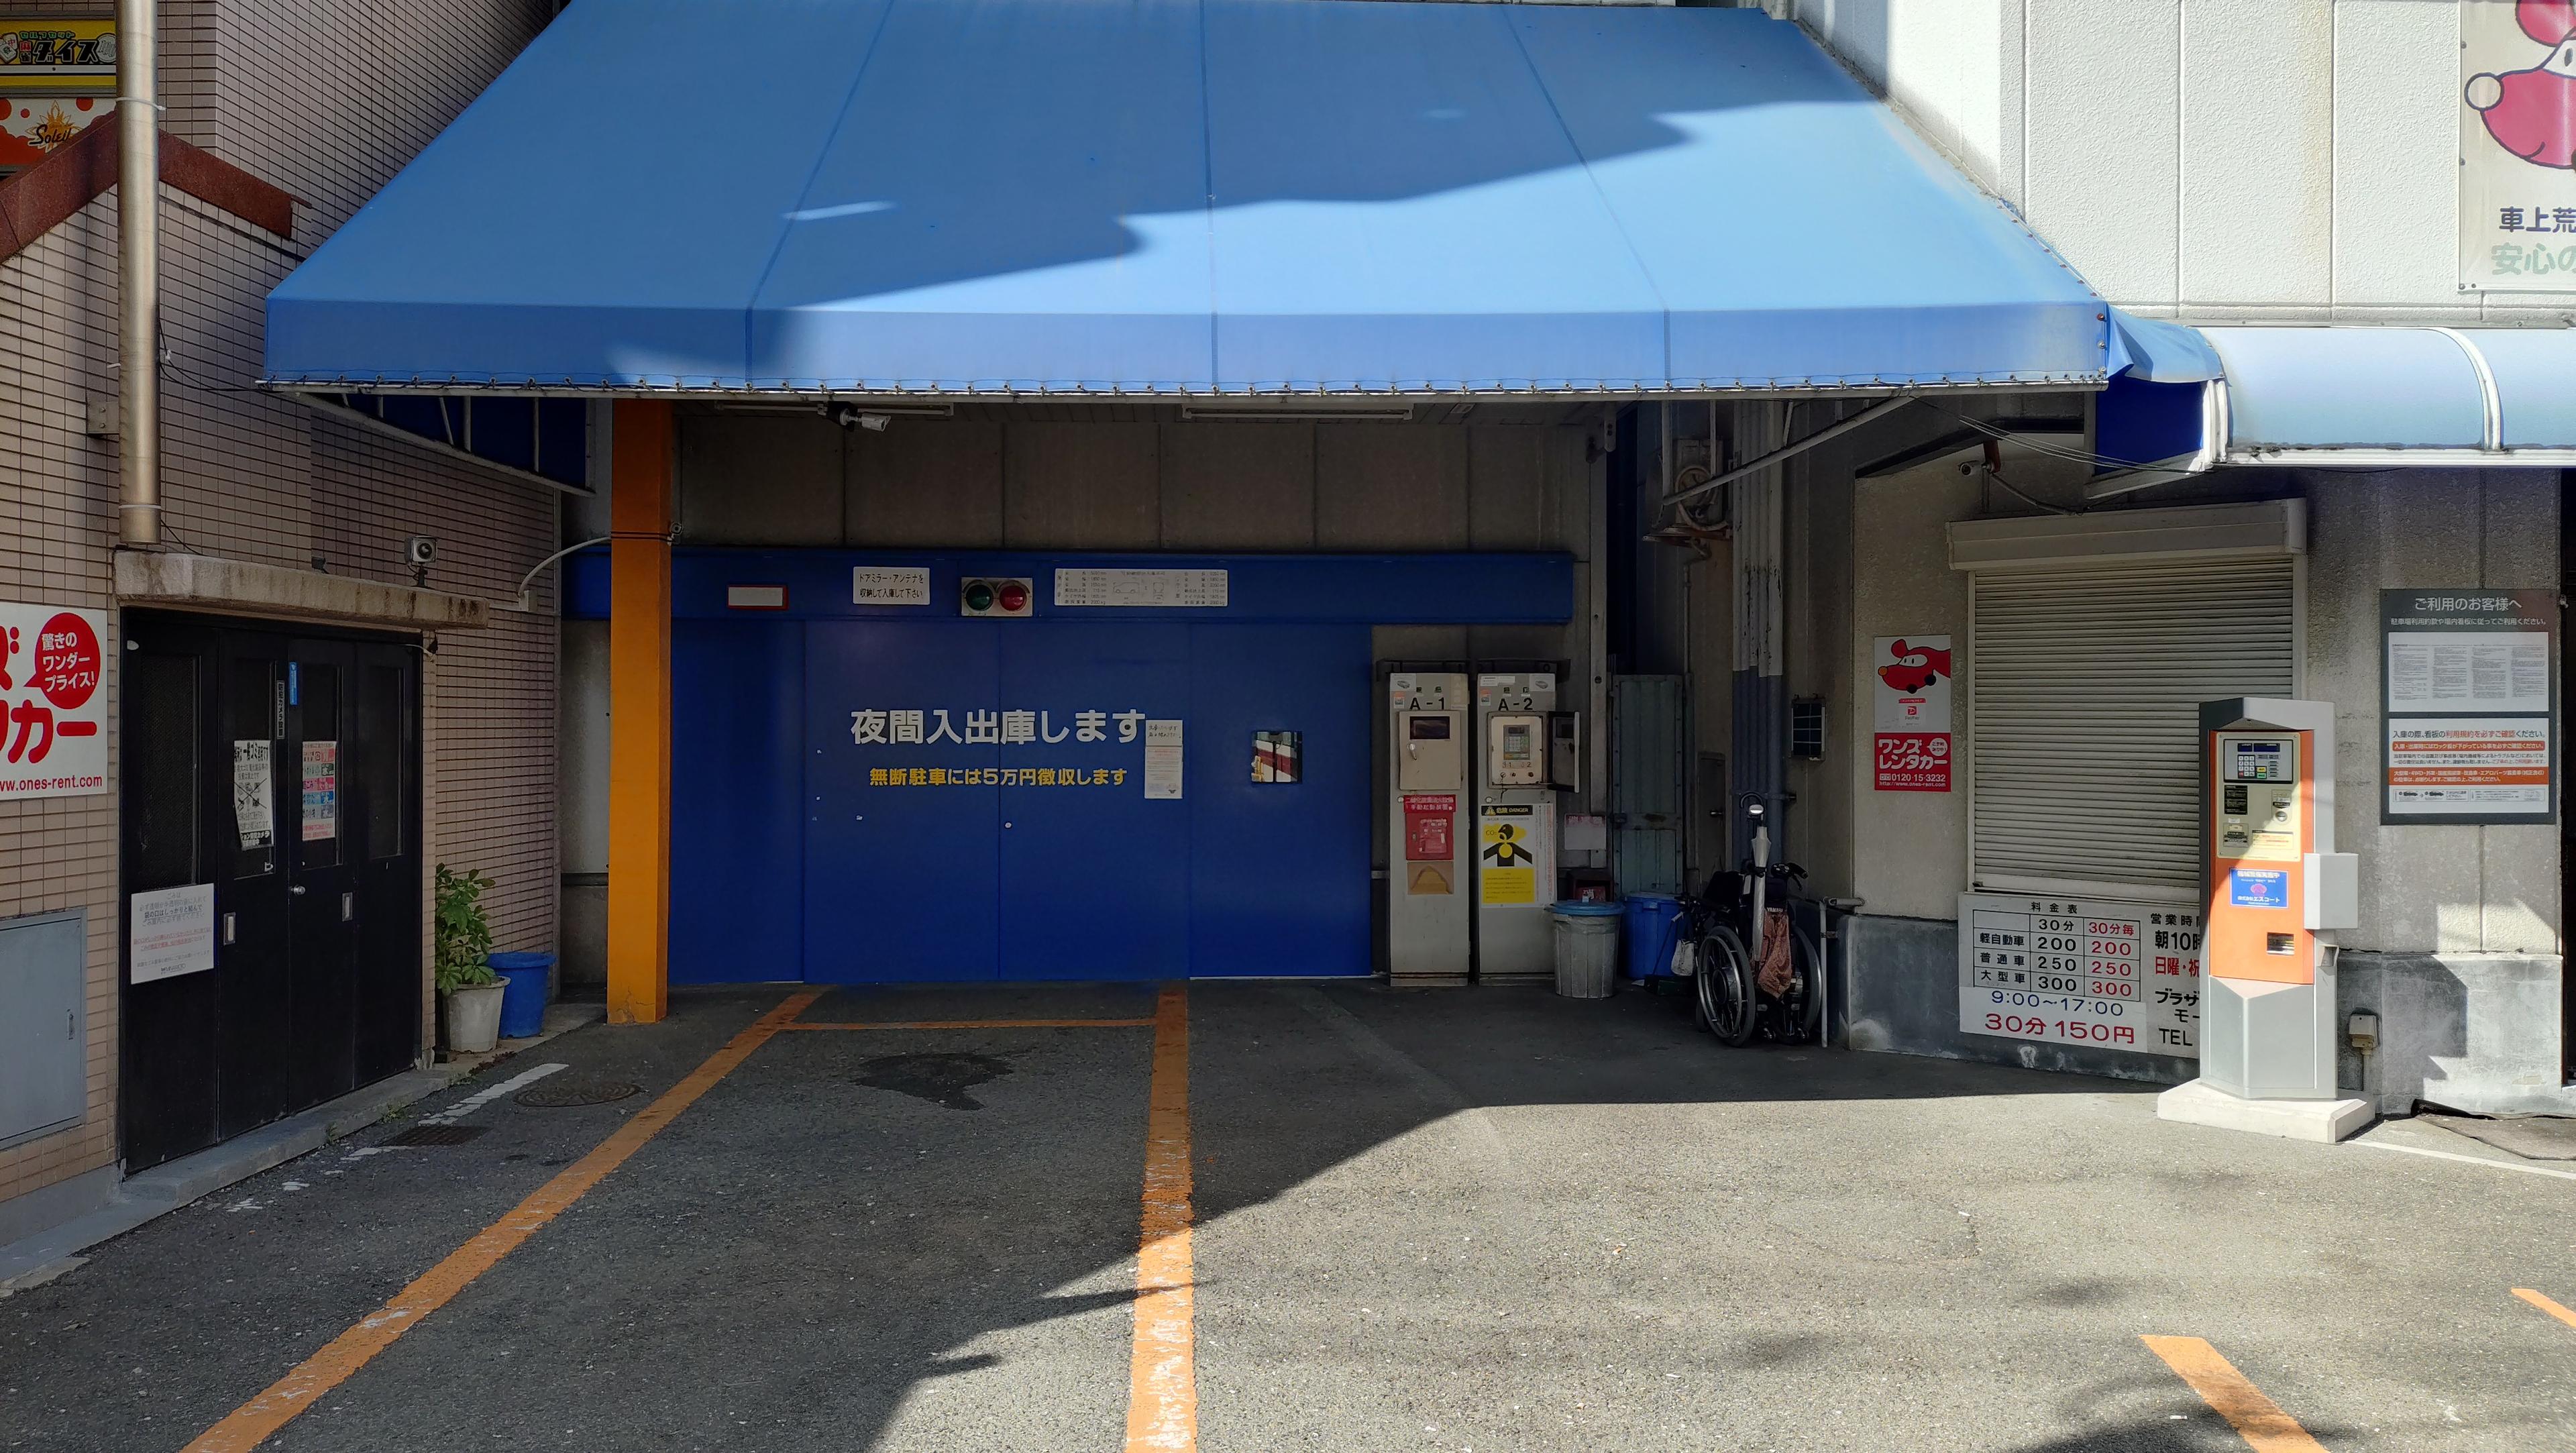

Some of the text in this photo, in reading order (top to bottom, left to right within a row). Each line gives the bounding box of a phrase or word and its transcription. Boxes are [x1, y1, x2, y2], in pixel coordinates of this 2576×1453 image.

[34, 40, 99, 62] ダイス
[29, 124, 71, 145] Soleil
[859, 574, 923, 584] ドアミラー・アンテナを
[859, 588, 923, 598] 収納して入庫して下さい
[2414, 597, 2522, 611] ご利用のお客様へ
[42, 632, 77, 651] 驚きの
[42, 651, 91, 671] ワンダー
[0, 699, 97, 763] カー
[850, 708, 1146, 745] 夜間入出庫します
[1878, 739, 1923, 754] ワンズ
[1879, 754, 1948, 770] レンタカー
[869, 767, 1128, 786] 無断駐車には5万円徴収します
[2031, 902, 2078, 914] 料金表
[2038, 918, 2074, 932] 30分
[2150, 913, 2200, 927] 営業時
[2088, 922, 2135, 936] 30分毎
[1980, 932, 2025, 947] 軽自動車
[2037, 936, 2076, 952] 200
[2091, 940, 2131, 956] 200
[1980, 952, 2025, 967] 普通車
[2037, 956, 2076, 971] 250
[1980, 969, 2025, 984] 大型車
[2091, 961, 2131, 977] 250
[2038, 976, 2077, 992] 300
[2091, 981, 2132, 997] 300
[1985, 1013, 2135, 1044] 30分 150円
[2159, 1028, 2193, 1046] TEL
